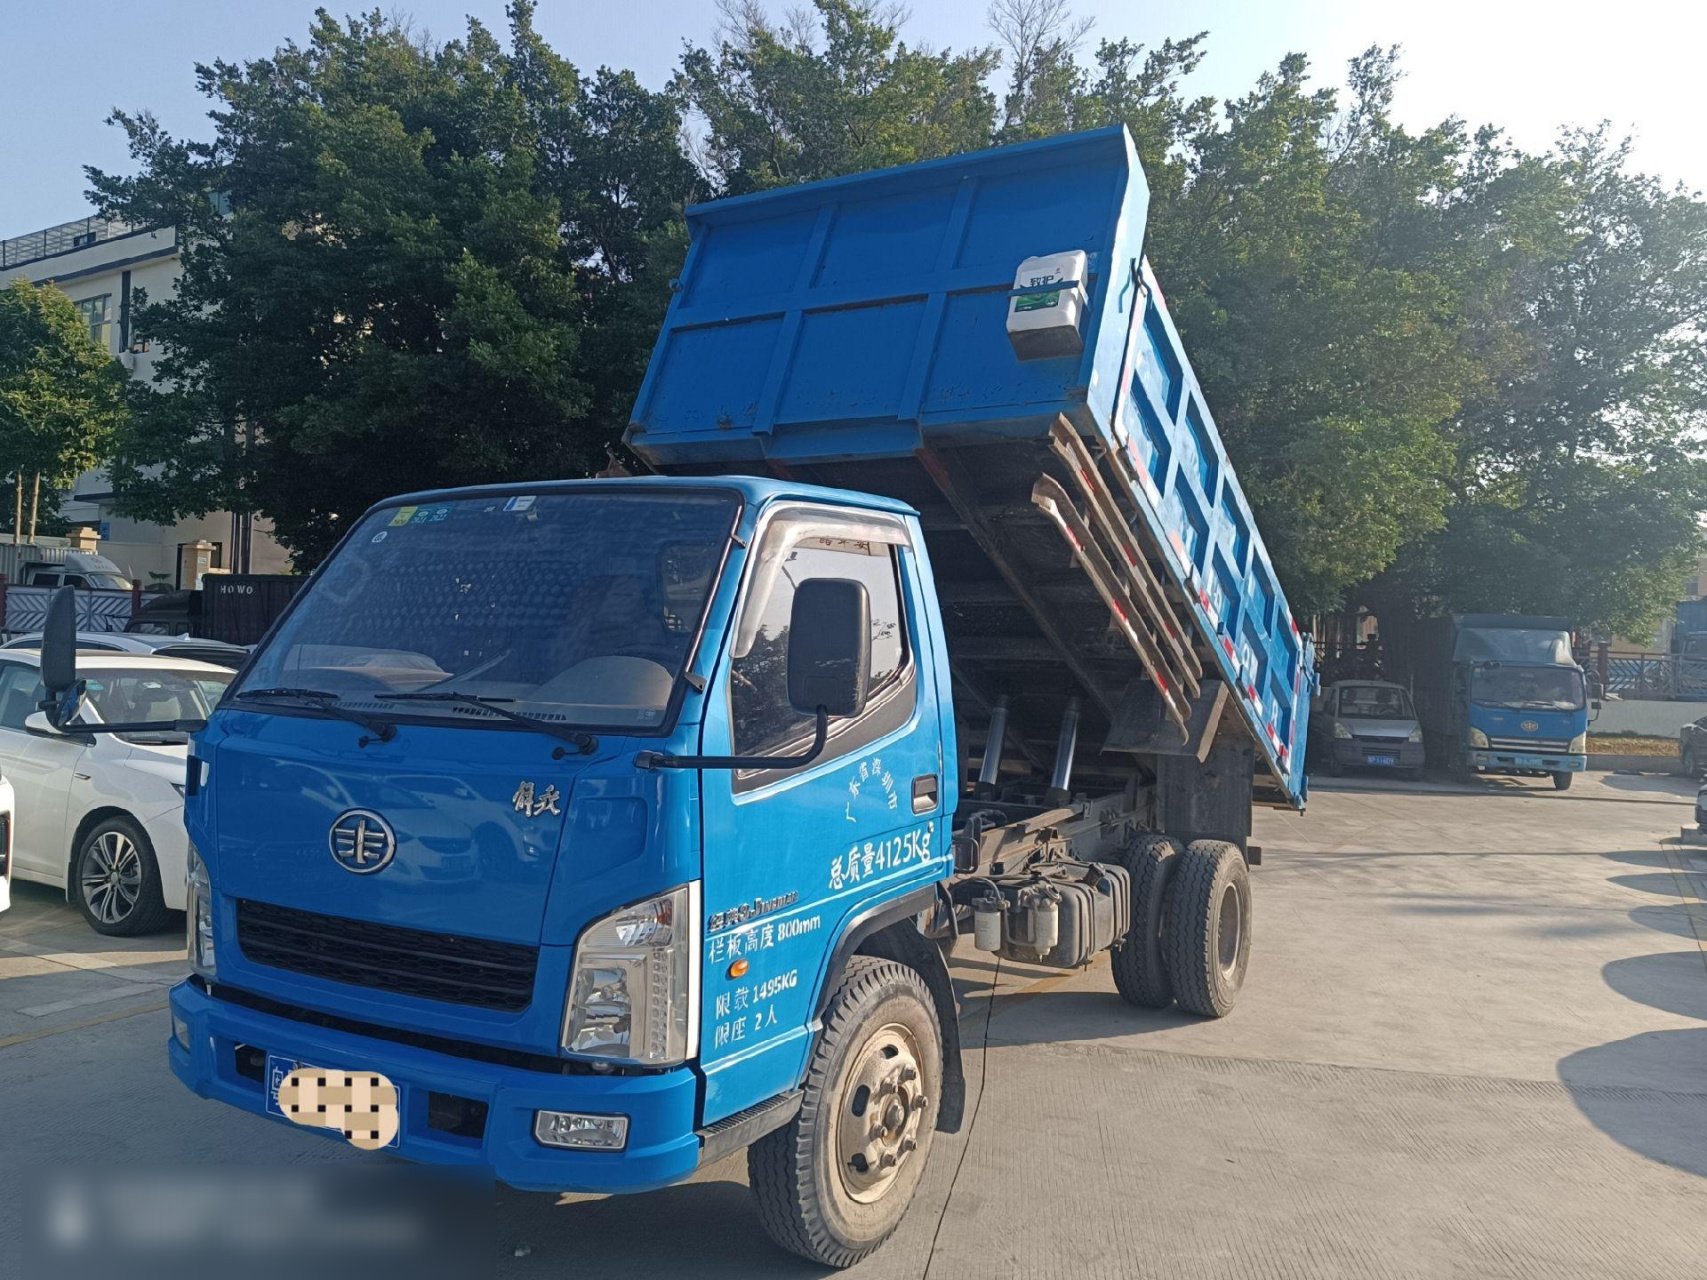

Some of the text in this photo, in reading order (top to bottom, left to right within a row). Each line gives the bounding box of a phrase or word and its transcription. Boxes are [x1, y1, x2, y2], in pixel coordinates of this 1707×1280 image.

[220, 585, 253, 595] HOWO
[708, 915, 821, 964] 栏板高度 800mm
[753, 969, 798, 1004] 1495KG
[715, 1016, 747, 1050] 限座
